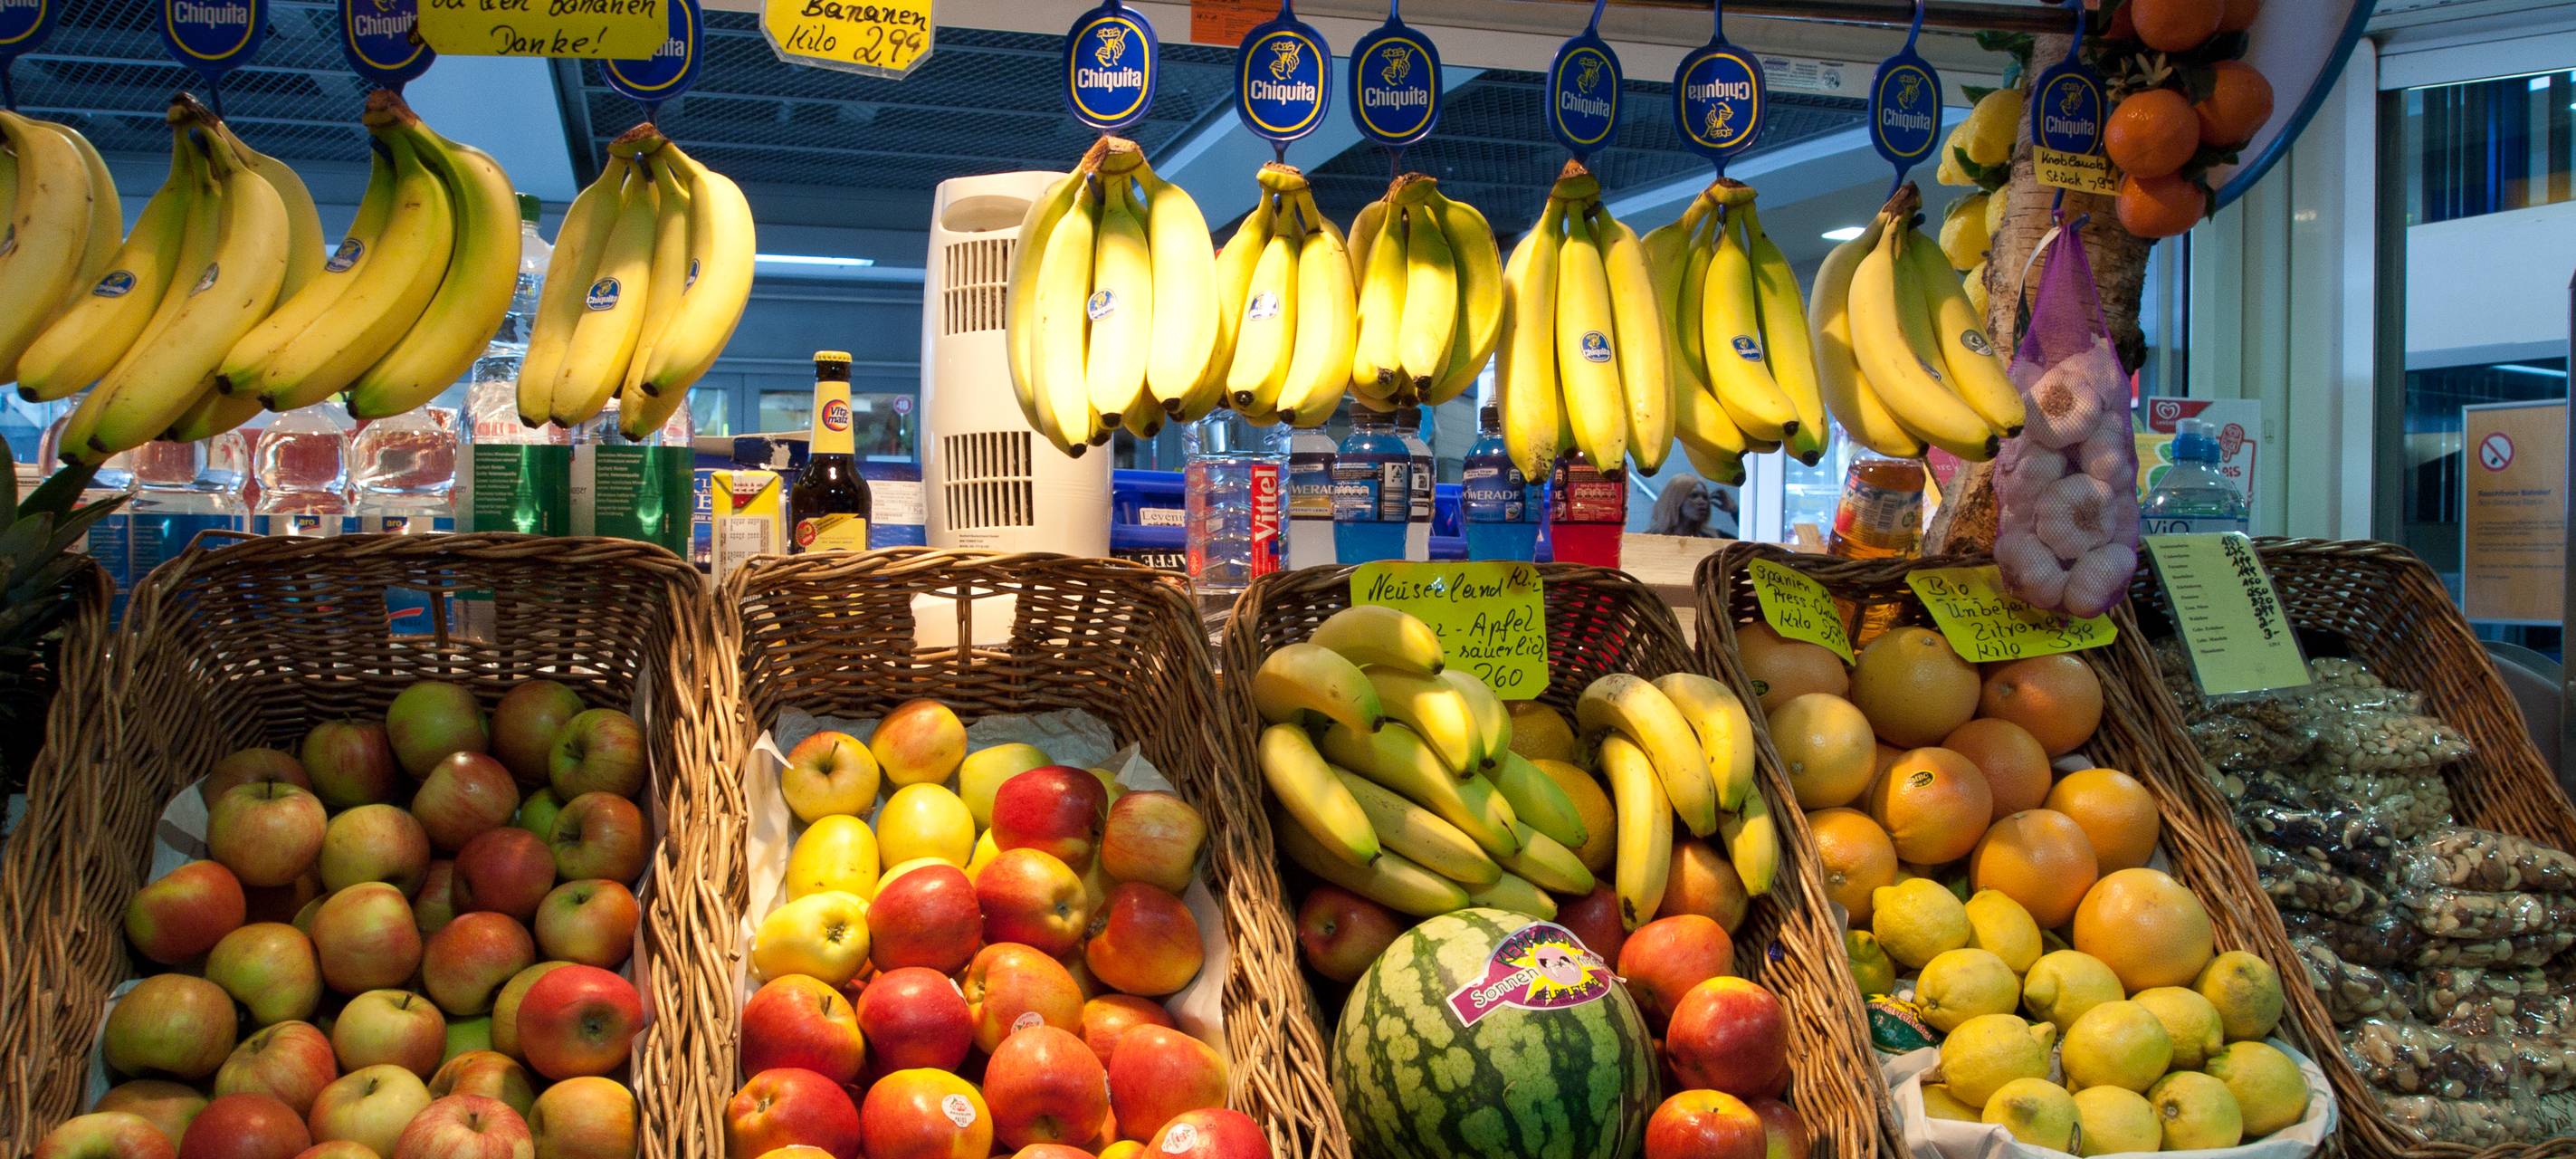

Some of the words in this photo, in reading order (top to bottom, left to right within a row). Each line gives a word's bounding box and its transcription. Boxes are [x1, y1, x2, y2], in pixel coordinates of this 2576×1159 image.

[175, 4, 247, 29] Chiquita
[801, 0, 927, 32] Bananen
[355, 14, 417, 43] Chiquit
[491, 25, 608, 55] Danke!
[786, 24, 836, 52] Kilo
[1077, 68, 1142, 92] Chiquita
[1250, 79, 1316, 105] Chiquita
[1688, 78, 1751, 101] Chiquita
[1364, 86, 1428, 111] Chiquita
[1560, 90, 1610, 119] Chiquita
[1882, 107, 1932, 133] Chiquita
[2046, 115, 2095, 139] Chiquita
[2046, 169, 2083, 187] Stück
[586, 294, 617, 305] Chiquita
[1582, 348, 1611, 359] Chiquita
[1255, 469, 1277, 543] Vittel
[299, 518, 315, 527] aro
[386, 519, 403, 528] aro
[1756, 564, 1813, 593] Spanien
[1918, 576, 1970, 596] Bio
[1773, 588, 1807, 608] Press
[1779, 608, 1811, 630] Kilo
[1976, 642, 2021, 661] Kilo
[1470, 967, 1541, 1009] Sonnen
